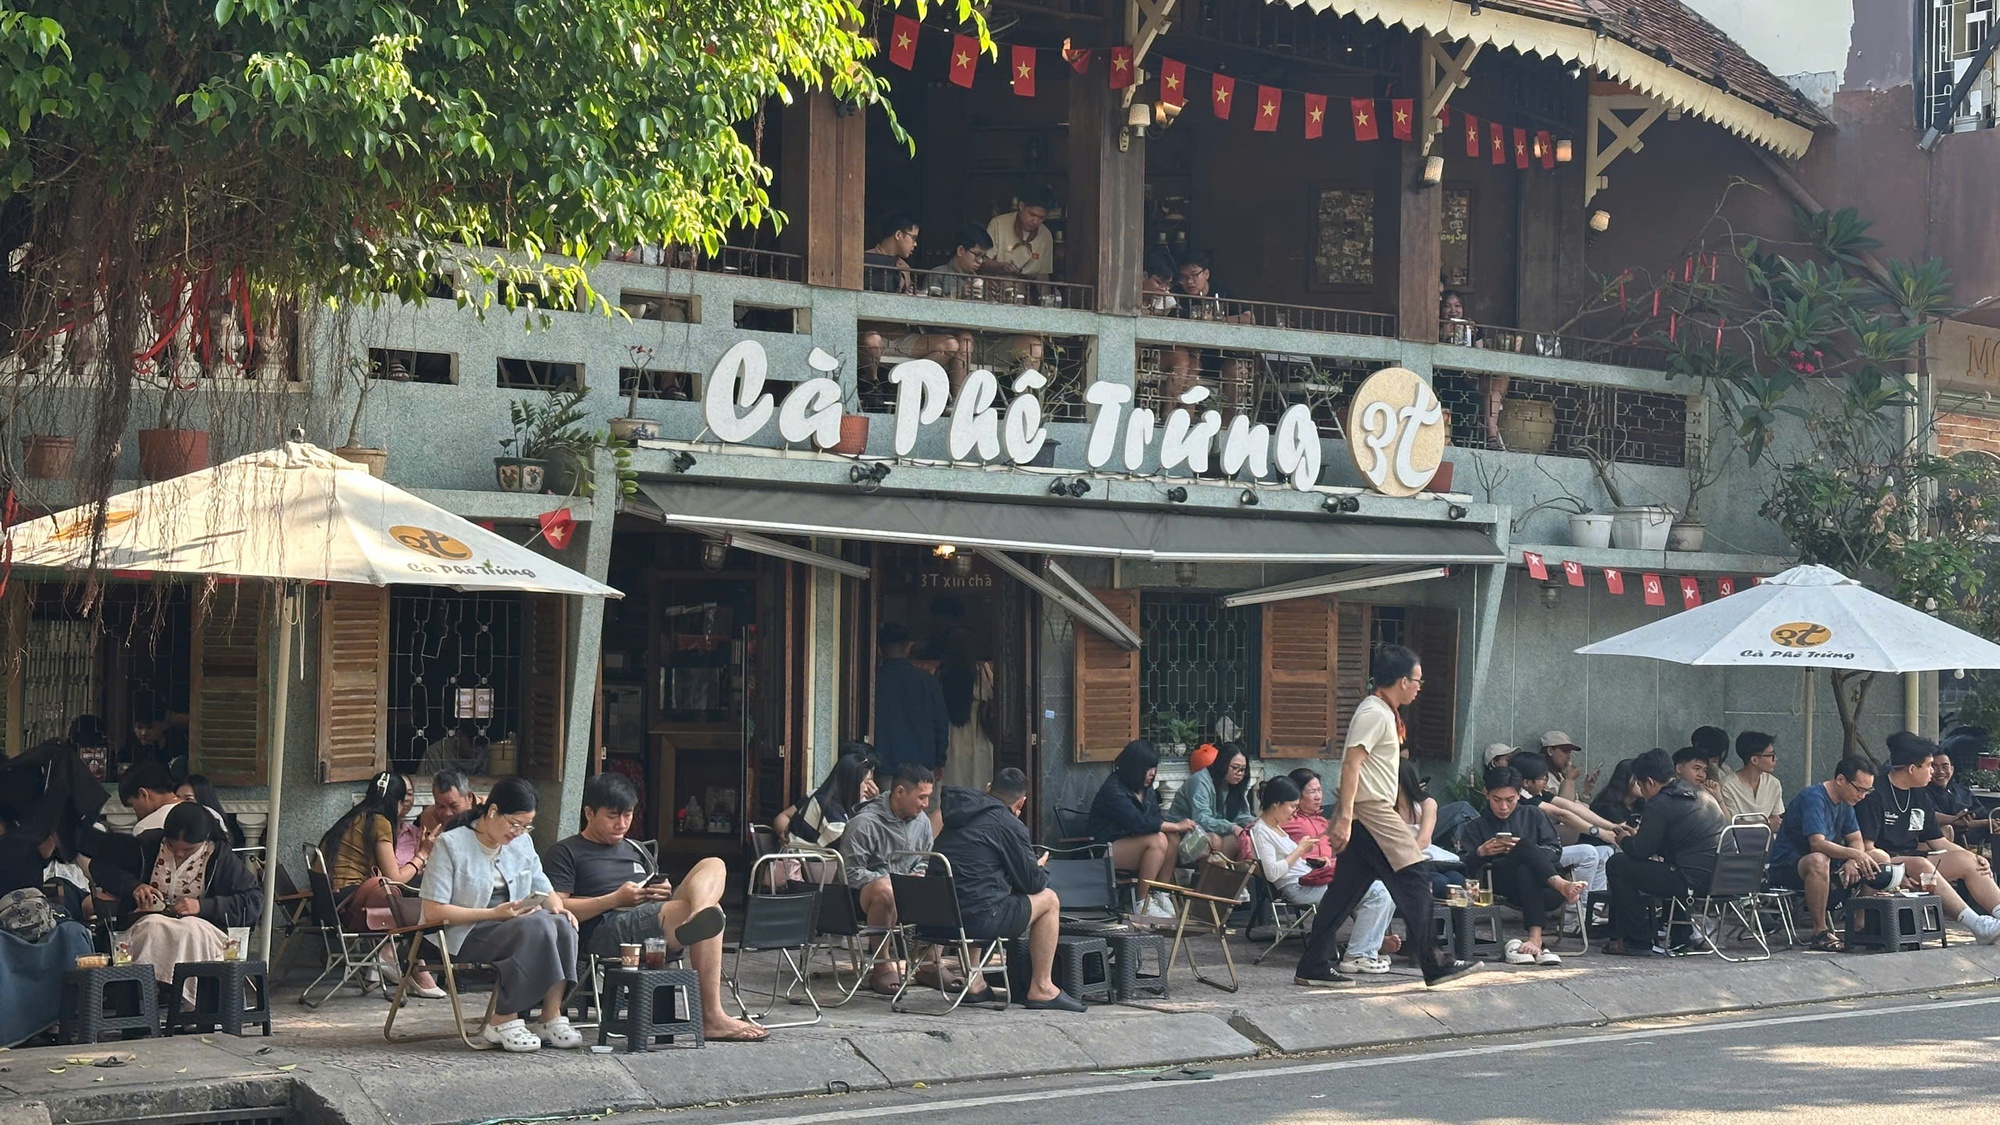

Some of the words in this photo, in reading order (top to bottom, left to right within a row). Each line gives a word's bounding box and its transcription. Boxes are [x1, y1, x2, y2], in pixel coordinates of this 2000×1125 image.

[705, 340, 843, 449] Cà
[888, 359, 1047, 464] Phê
[1084, 380, 1321, 491] Trứng
[407, 562, 437, 573] Cà
[438, 565, 478, 575] Phê
[943, 575, 965, 587] xin
[1740, 649, 1764, 658] Cà
[1769, 650, 1803, 658] Phê
[1807, 650, 1856, 660] Trứng
